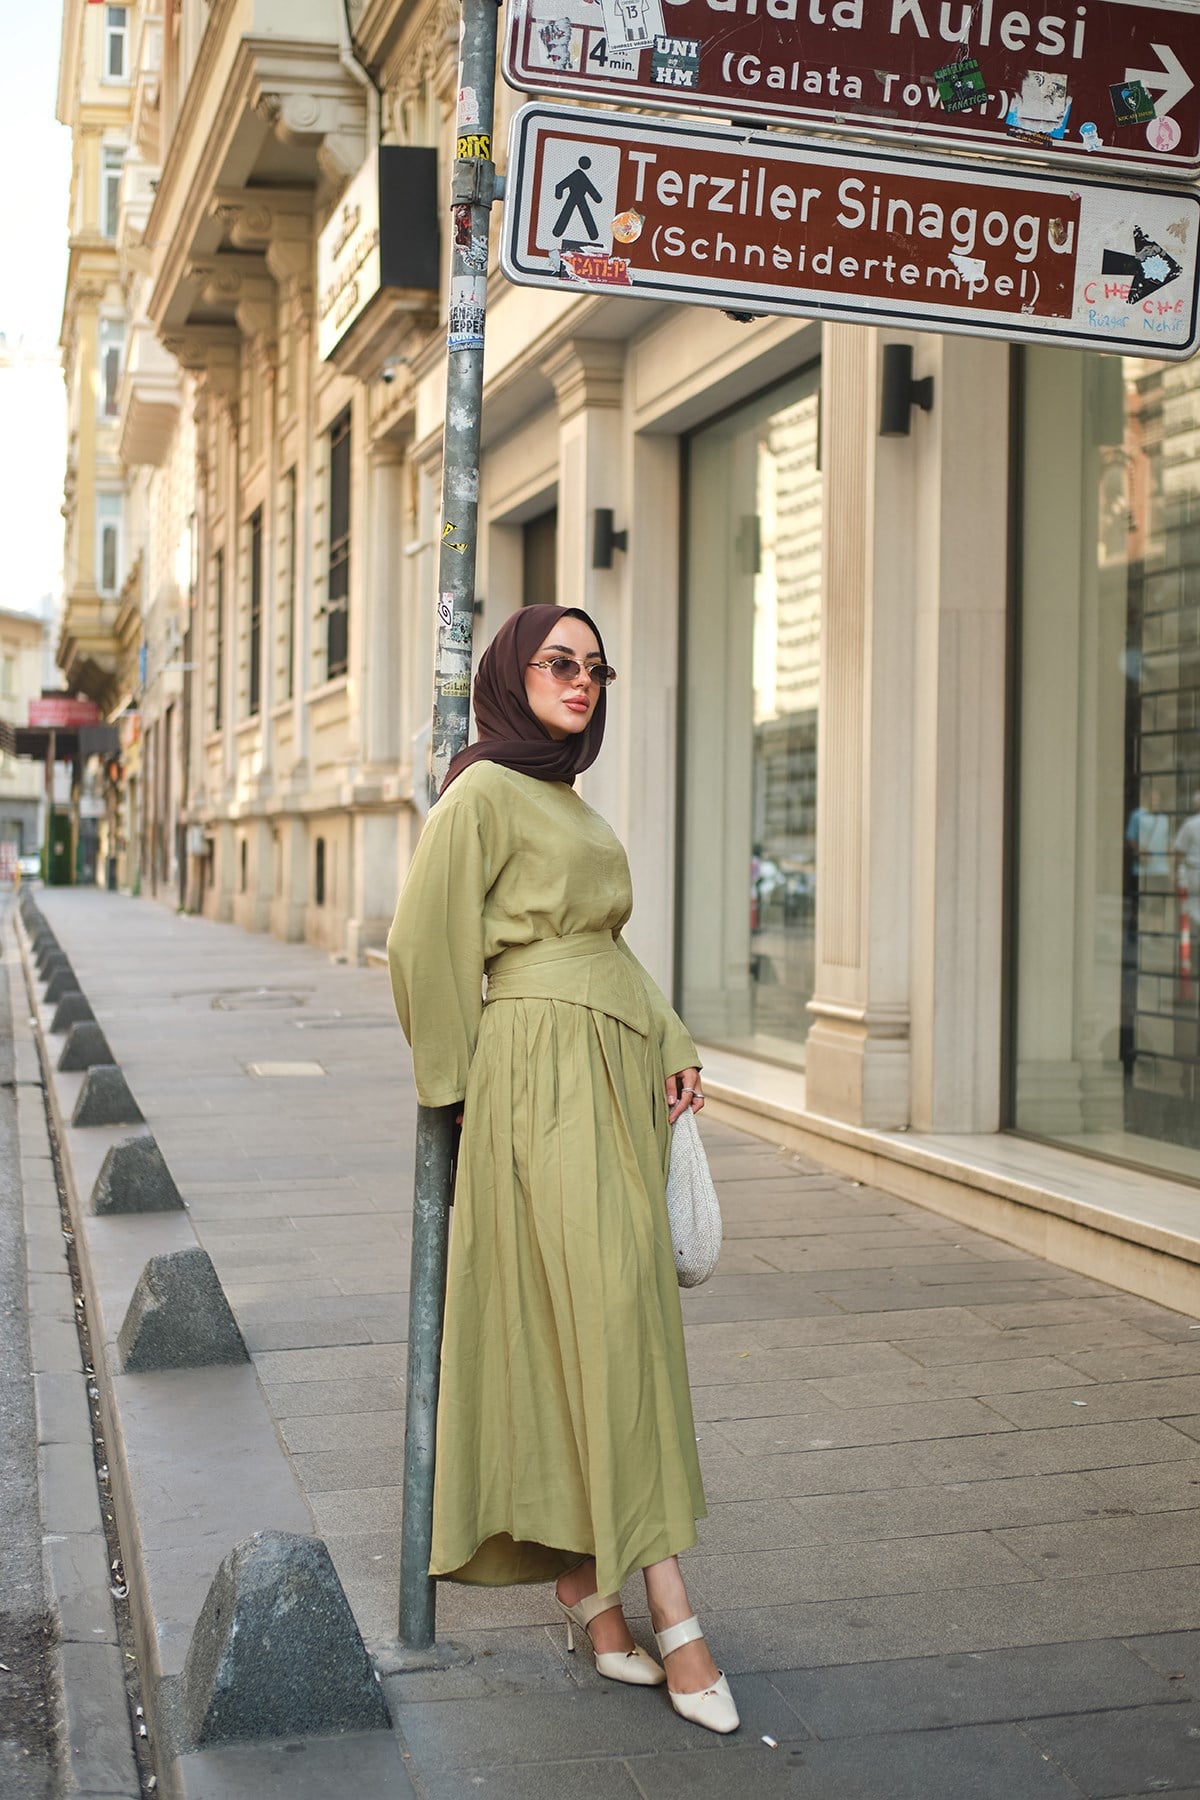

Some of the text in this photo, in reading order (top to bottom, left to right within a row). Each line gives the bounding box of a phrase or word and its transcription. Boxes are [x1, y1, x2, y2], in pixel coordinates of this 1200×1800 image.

[626, 5, 638, 19] 13
[889, 0, 1086, 59] Kulesi
[589, 37, 635, 71] 4 min.
[656, 38, 699, 58] UNI
[656, 67, 695, 87] HM
[722, 52, 1008, 119] (Galata Towr)
[947, 93, 988, 112] FANATICS
[628, 151, 1075, 263] Terziler Sinagogu
[651, 225, 1040, 304] (Schneidertempel)
